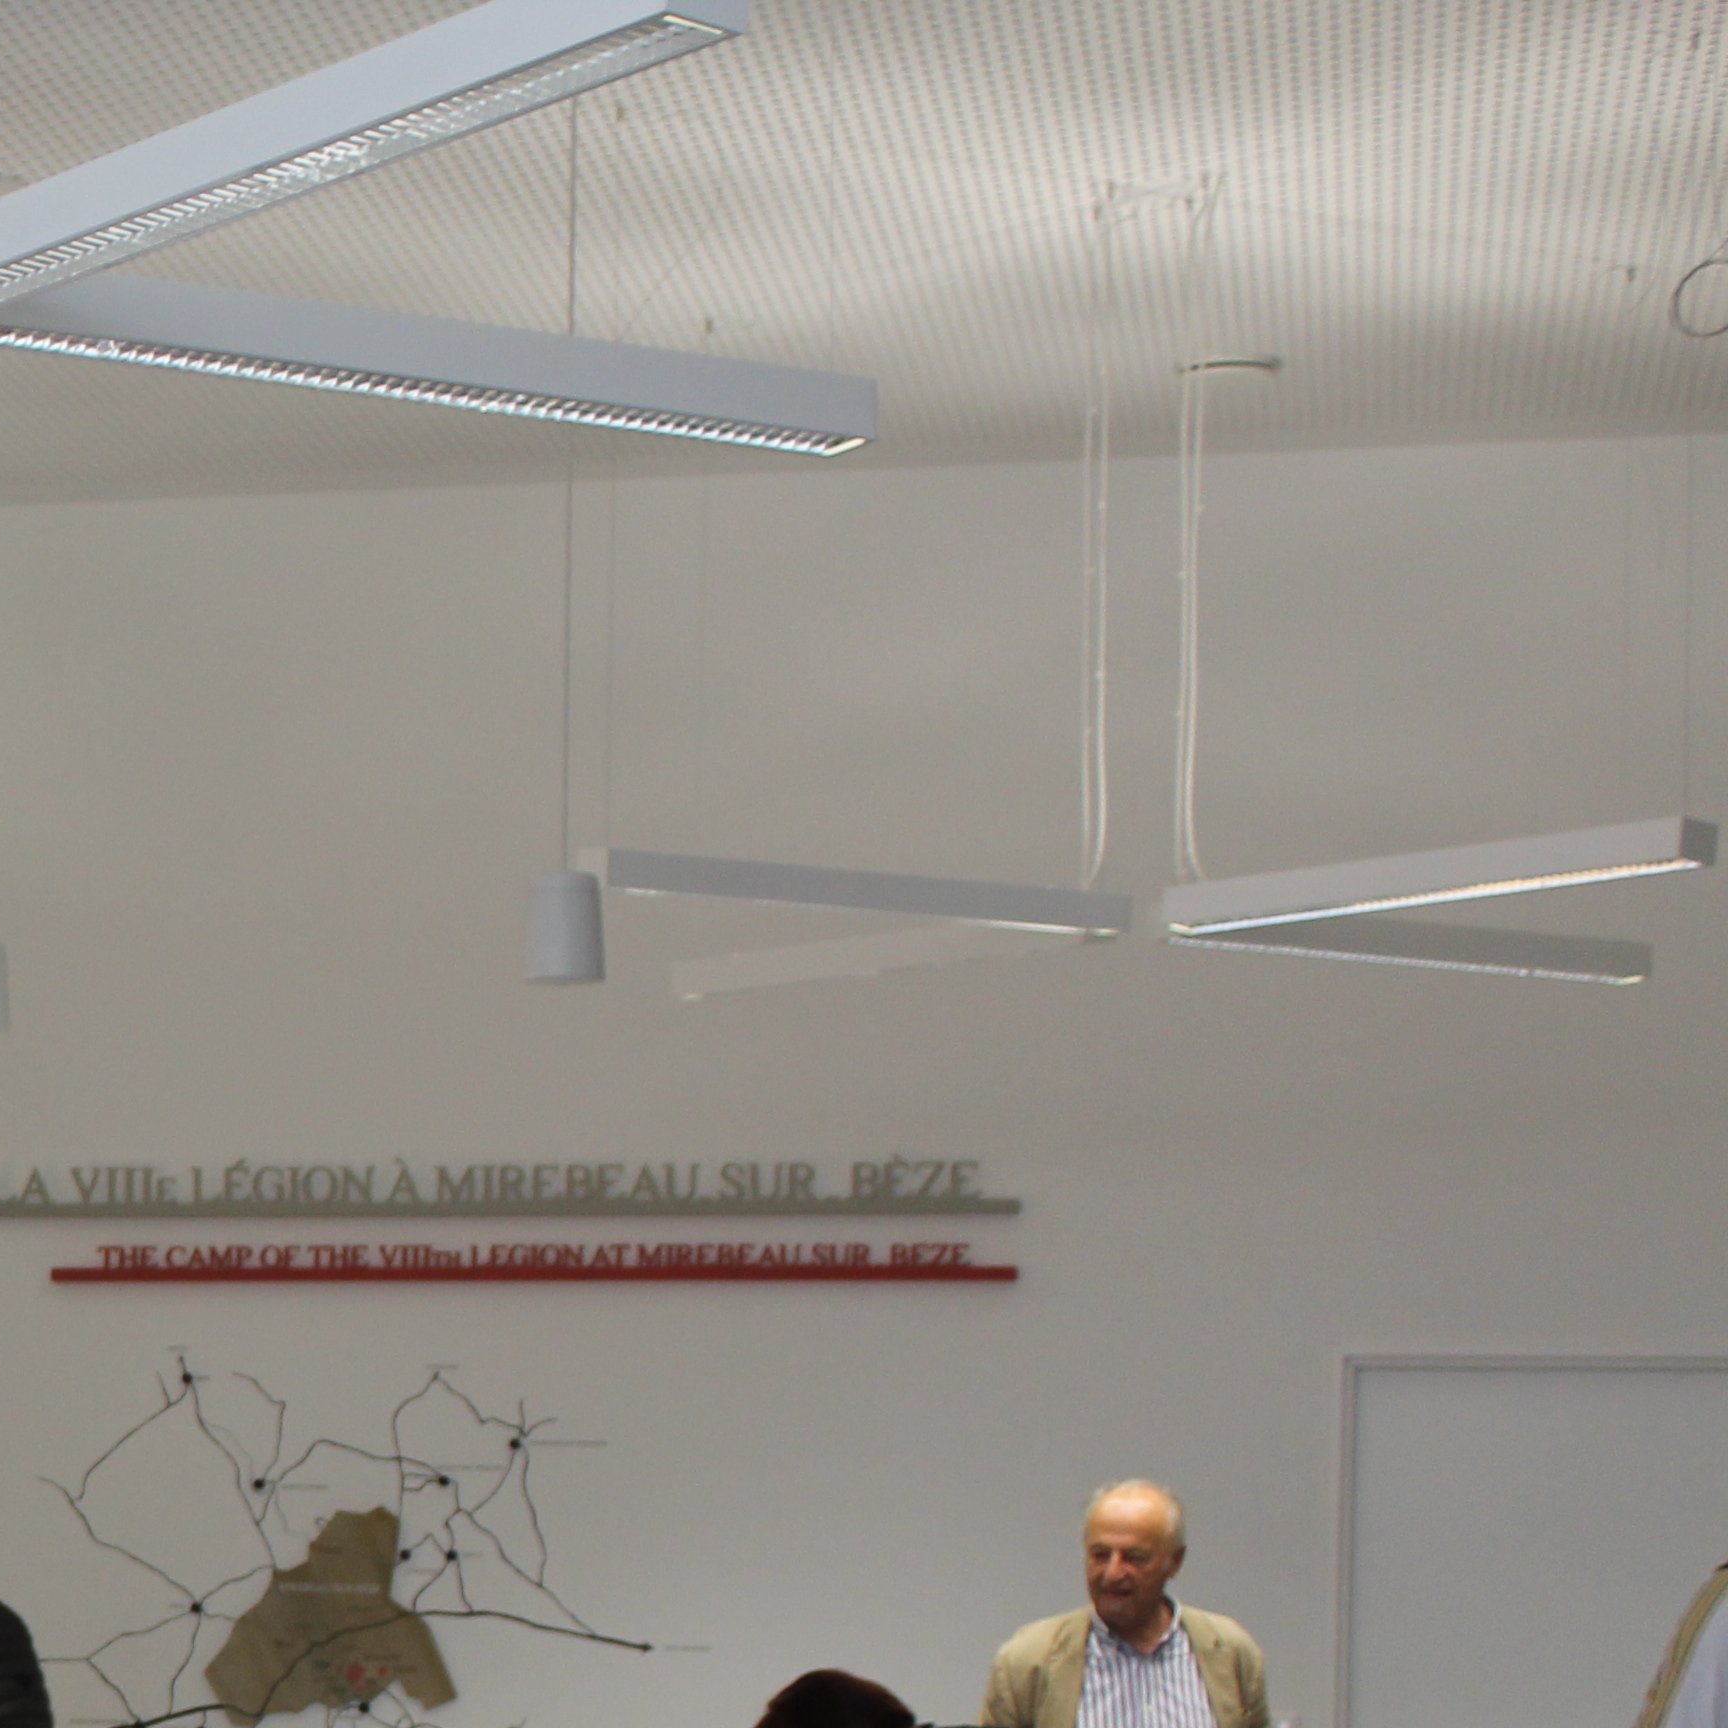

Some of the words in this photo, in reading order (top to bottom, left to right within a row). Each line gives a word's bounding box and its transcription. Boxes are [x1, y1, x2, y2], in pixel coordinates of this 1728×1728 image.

[191, 1158, 376, 1203] LÉGION
[435, 1162, 701, 1202] MIREBEAU
[717, 1160, 818, 1201] SUR
[850, 1153, 983, 1201] BÈZE
[97, 1245, 159, 1271] THE
[165, 1245, 253, 1271] CAMP
[259, 1245, 302, 1270] OF
[307, 1245, 369, 1270] THE
[470, 1244, 585, 1270] LEGION
[587, 1243, 631, 1269] AT
[637, 1243, 803, 1269] MIREBEAU
[811, 1242, 872, 1268] SUR
